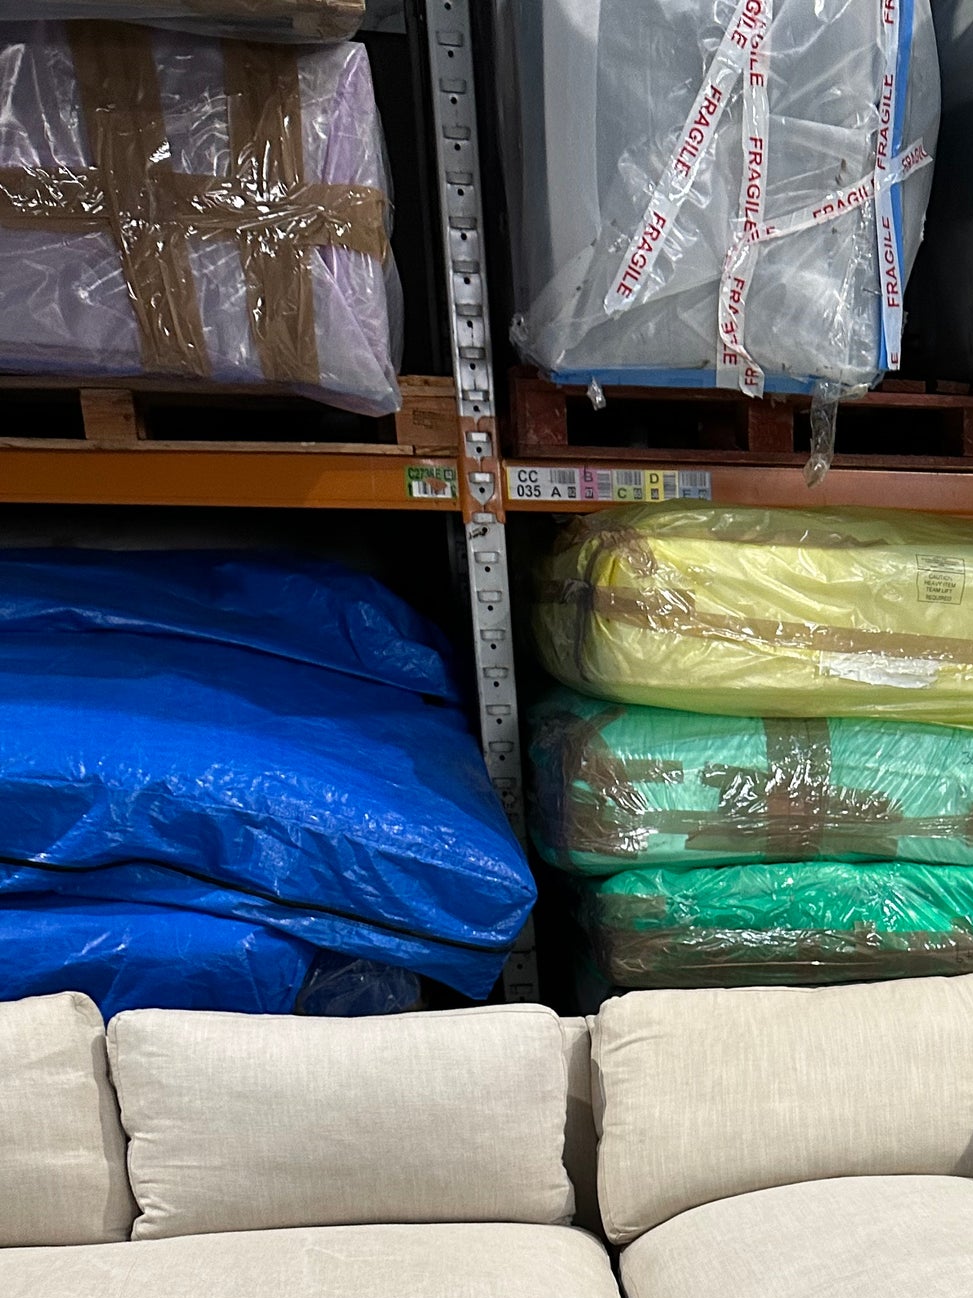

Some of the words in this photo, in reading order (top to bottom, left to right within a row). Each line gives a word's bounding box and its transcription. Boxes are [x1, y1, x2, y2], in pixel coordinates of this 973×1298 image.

[673, 85, 722, 178] FRAGILE
[876, 74, 894, 170] FRAGILE
[742, 136, 763, 234] FRAGILE
[616, 211, 667, 299] FRAGILE
[882, 216, 900, 308] FRAGILE
[516, 484, 542, 498] 035
[551, 486, 562, 498] A
[617, 487, 628, 499] C
[517, 470, 538, 483] CC
[650, 473, 659, 484] D
